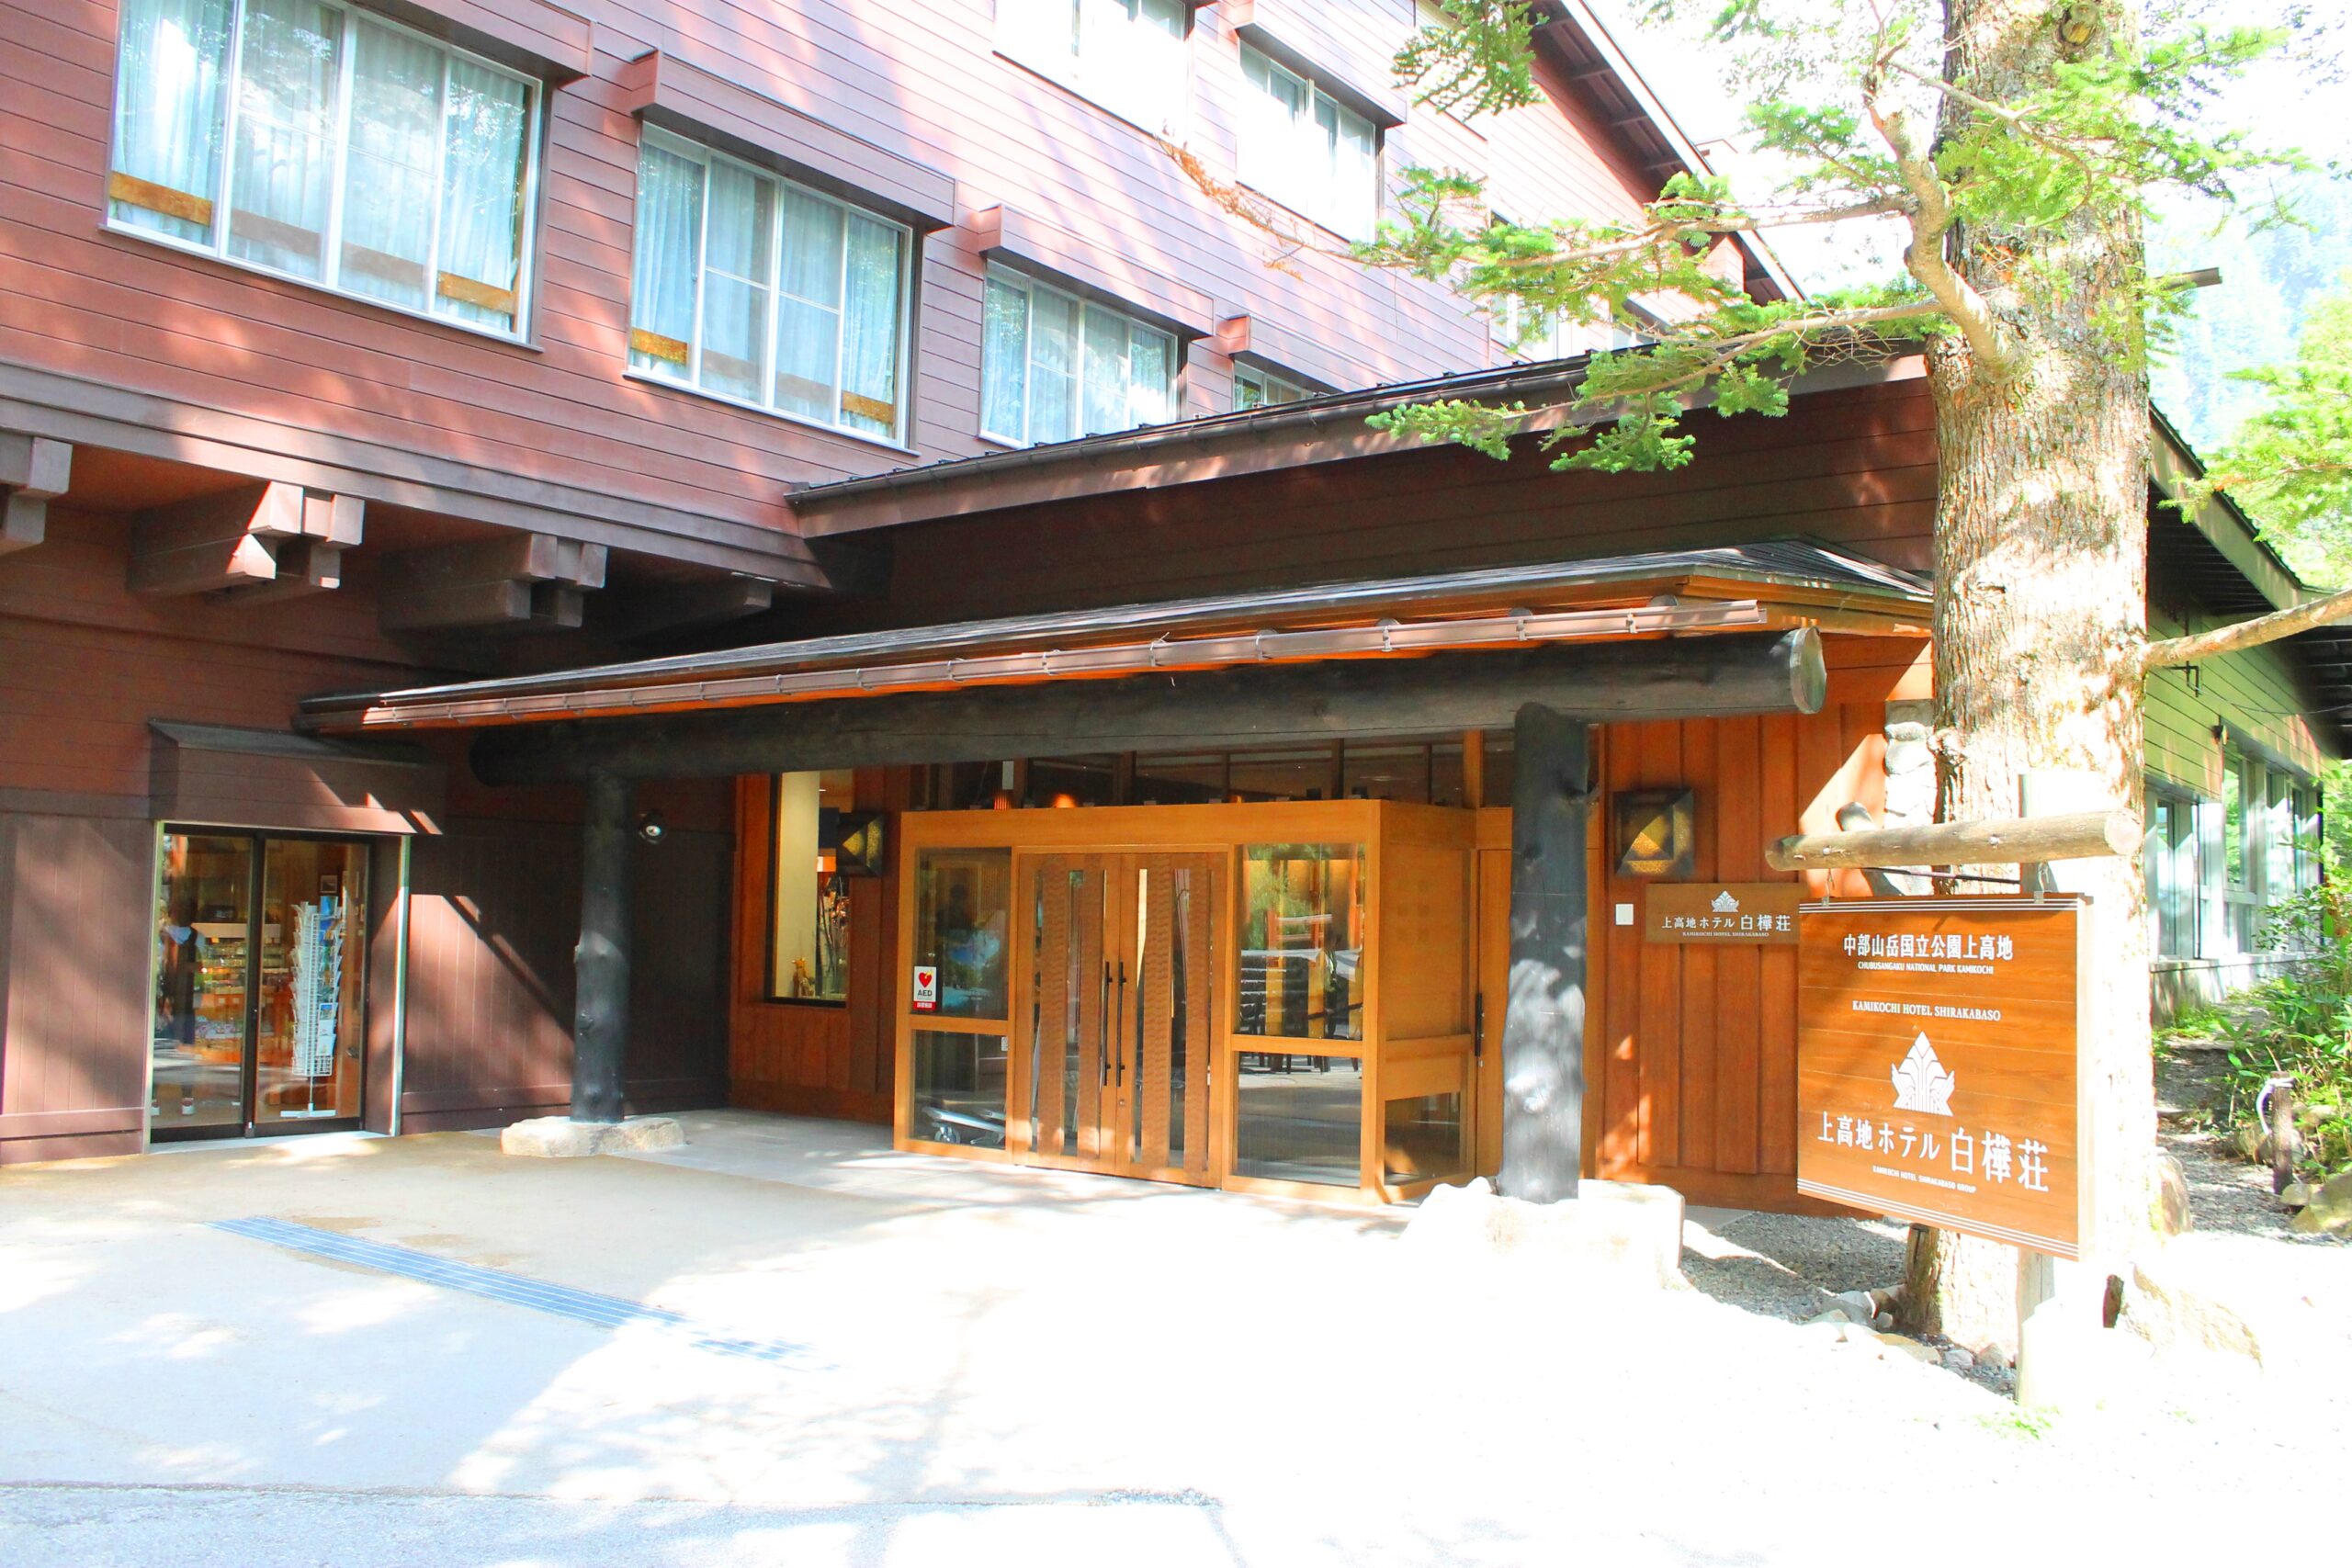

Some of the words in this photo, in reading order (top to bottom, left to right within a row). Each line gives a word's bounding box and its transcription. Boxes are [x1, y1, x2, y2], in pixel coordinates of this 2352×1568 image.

[1661, 917, 1736, 929] 上高地ホテル
[1843, 933, 2014, 960] 中部山岳国立公園上高地
[1858, 962, 1905, 971] CHUBUSANGAKU
[1905, 963, 1937, 972] NATIONAL
[1939, 964, 1956, 973] PARK
[1957, 964, 1994, 975] KAMIKOCHI
[1852, 1000, 1900, 1014] KAMIKOCHI
[1903, 1003, 1932, 1017] HOTEL
[1934, 1007, 2001, 1021] SHIRAKABASO
[1817, 1111, 1940, 1160] 上高地ホテル
[1951, 1127, 2049, 1192] 白樺荘
[1872, 1166, 1899, 1178] KAMIKOCHI
[1900, 1171, 1917, 1181] HOTEL
[1917, 1175, 1956, 1190] SHIRAKABASO
[1957, 1183, 1976, 1193] GROUP
